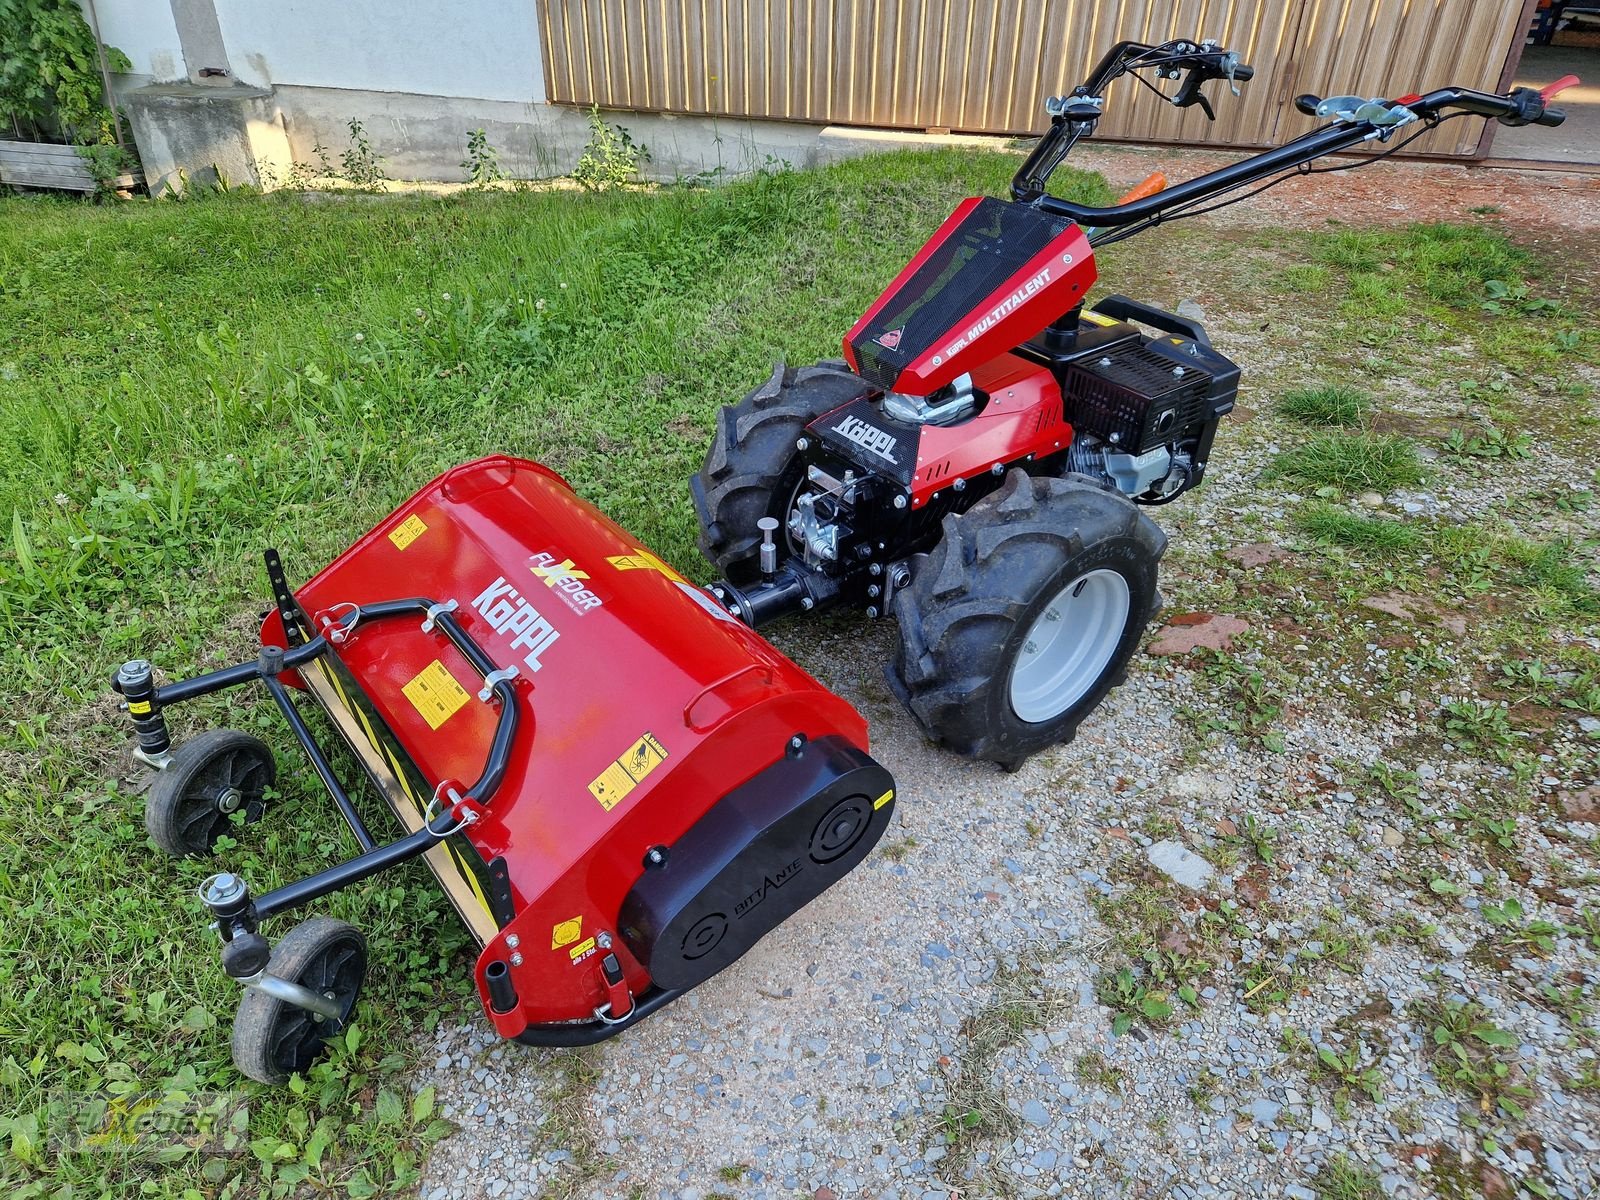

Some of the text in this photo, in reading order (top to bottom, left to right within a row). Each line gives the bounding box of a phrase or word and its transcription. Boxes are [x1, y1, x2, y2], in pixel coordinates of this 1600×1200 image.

[967, 268, 1051, 341] MULTITALENT
[529, 552, 603, 610] FUXEDER
[734, 857, 802, 917] BITTANTE
